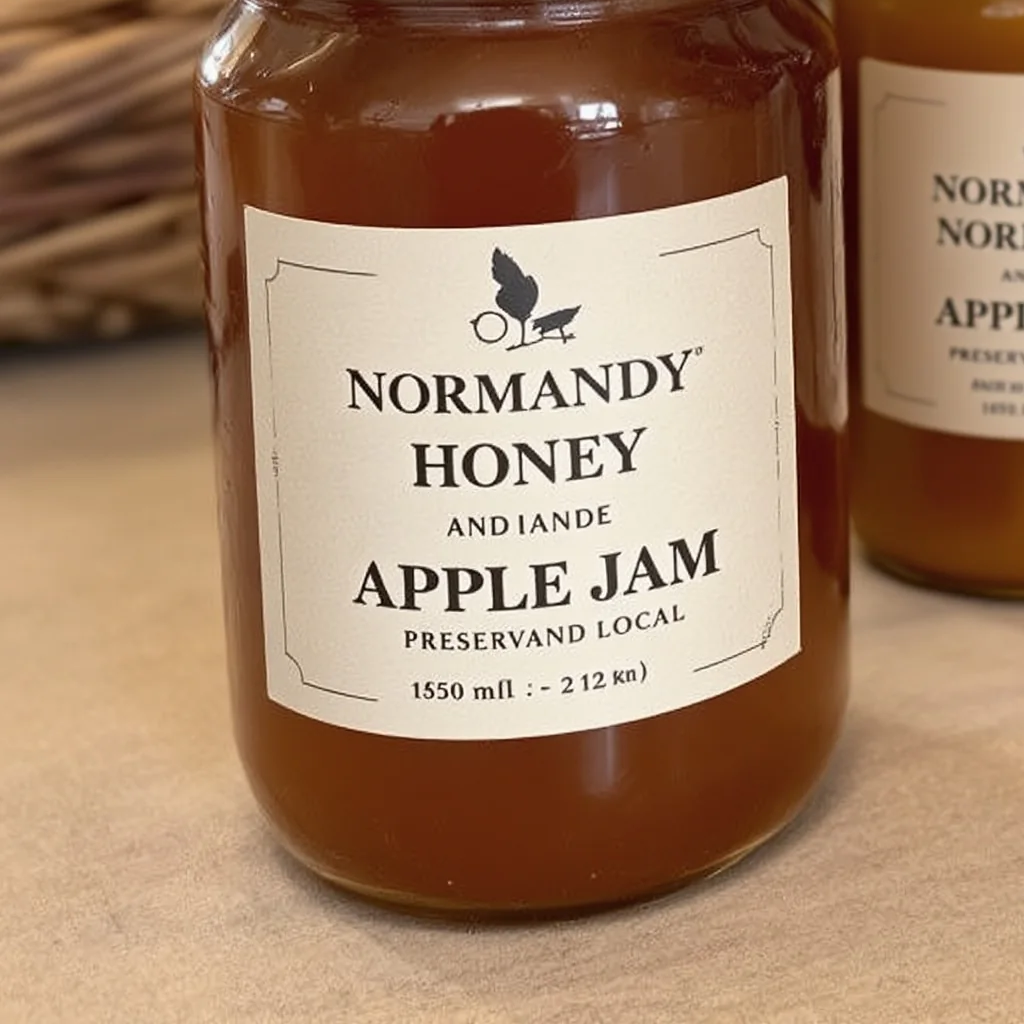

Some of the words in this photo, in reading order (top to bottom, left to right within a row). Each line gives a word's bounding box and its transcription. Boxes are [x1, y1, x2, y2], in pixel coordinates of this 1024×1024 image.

[410, 426, 648, 489] HONEY
[352, 560, 572, 613] APPLE
[589, 528, 721, 602] JAM
[403, 624, 586, 651] PRESERVAND
[597, 604, 686, 639] LOCAL
